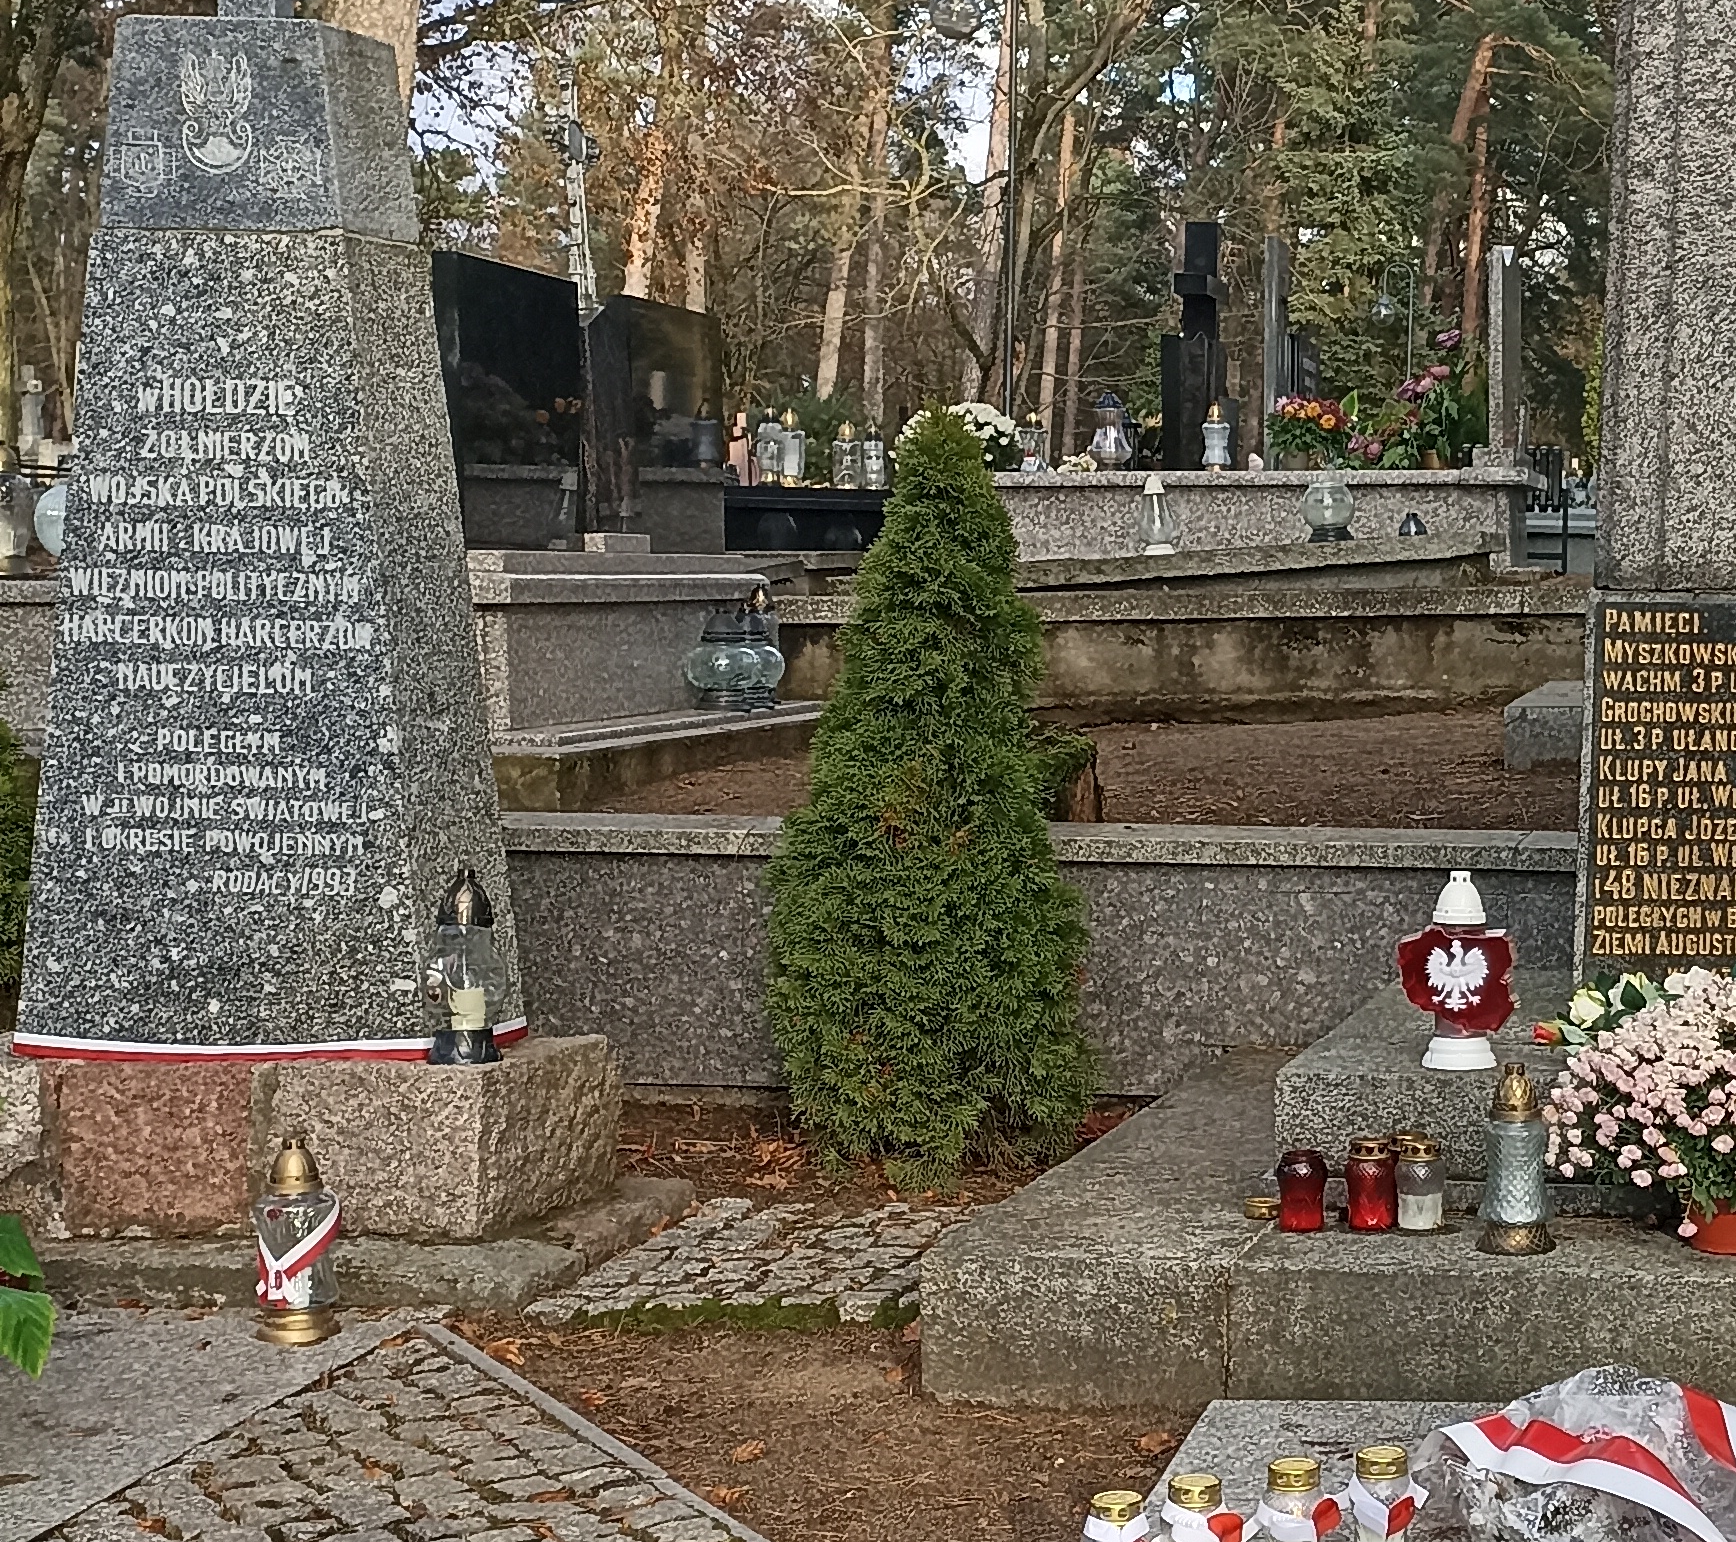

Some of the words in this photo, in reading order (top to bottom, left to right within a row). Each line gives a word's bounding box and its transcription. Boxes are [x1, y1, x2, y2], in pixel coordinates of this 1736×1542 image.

[90, 474, 194, 507] WOJSKA
[201, 477, 341, 508] POLSKIEGO
[194, 524, 330, 554] KRAJOWEJ
[1605, 608, 1709, 637] PAMIĘCI:
[1692, 667, 1705, 693] 3
[1633, 726, 1646, 751] 3
[1599, 755, 1667, 782] KLUPY
[1672, 757, 1727, 783] JANA
[1629, 783, 1650, 808] 16
[1677, 786, 1709, 809] UŁ.
[1628, 841, 1650, 866] 16
[212, 869, 300, 895] RODACY
[301, 867, 357, 896] 1993
[1604, 868, 1637, 900] 48
[1593, 905, 1702, 928] POLEGŁYCH
[1593, 929, 1650, 955] ZIEMI
